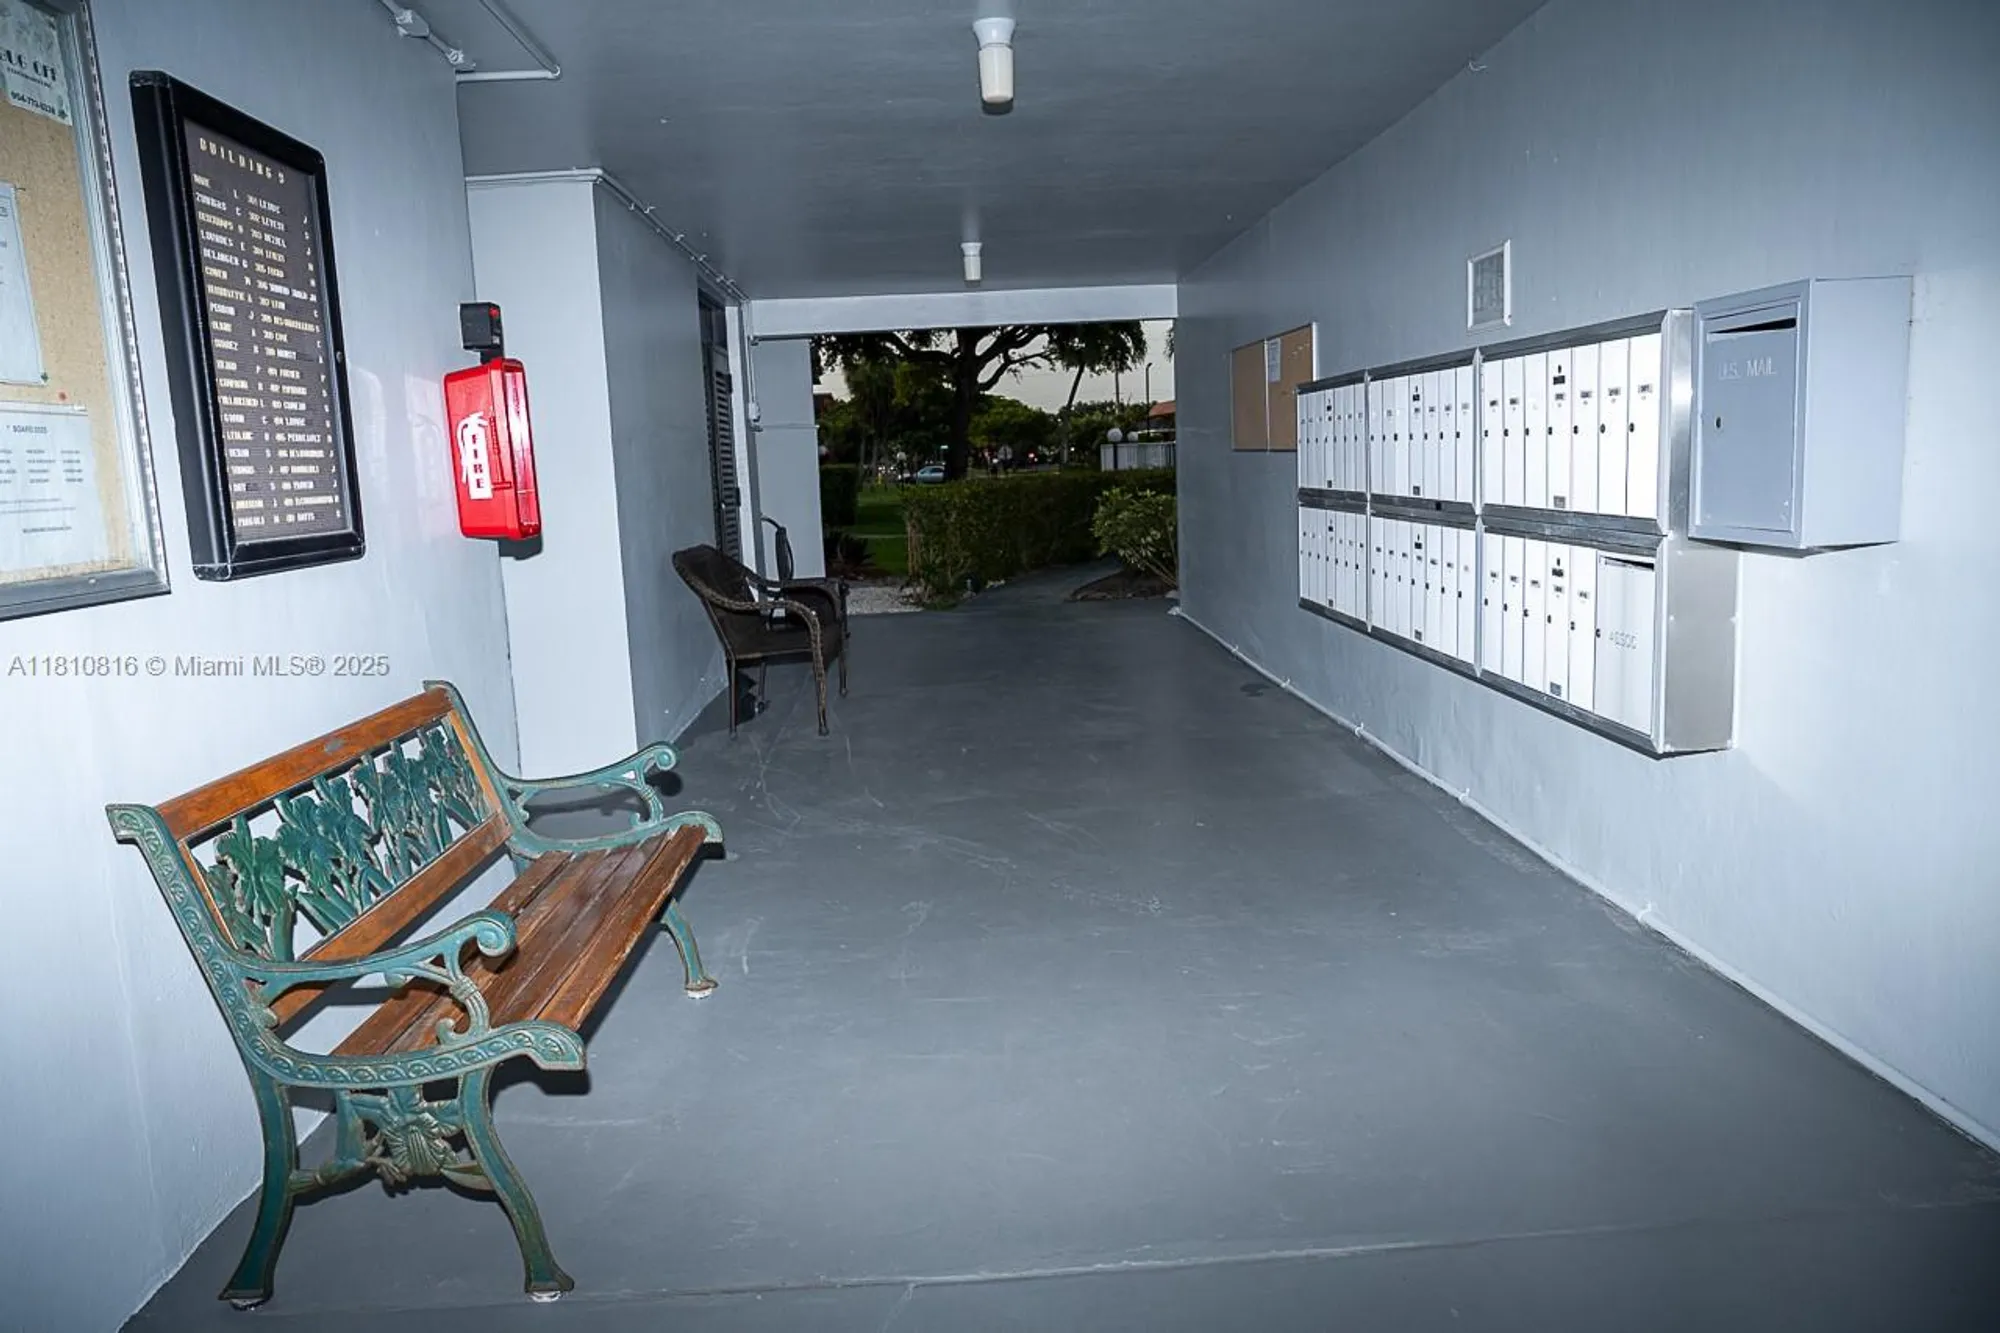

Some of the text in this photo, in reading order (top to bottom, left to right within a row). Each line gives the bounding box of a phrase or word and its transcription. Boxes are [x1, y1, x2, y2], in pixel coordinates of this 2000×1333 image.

[200, 137, 272, 179] BUILDING
[1746, 356, 1777, 377] MAIL
[472, 434, 484, 488] FIRE
